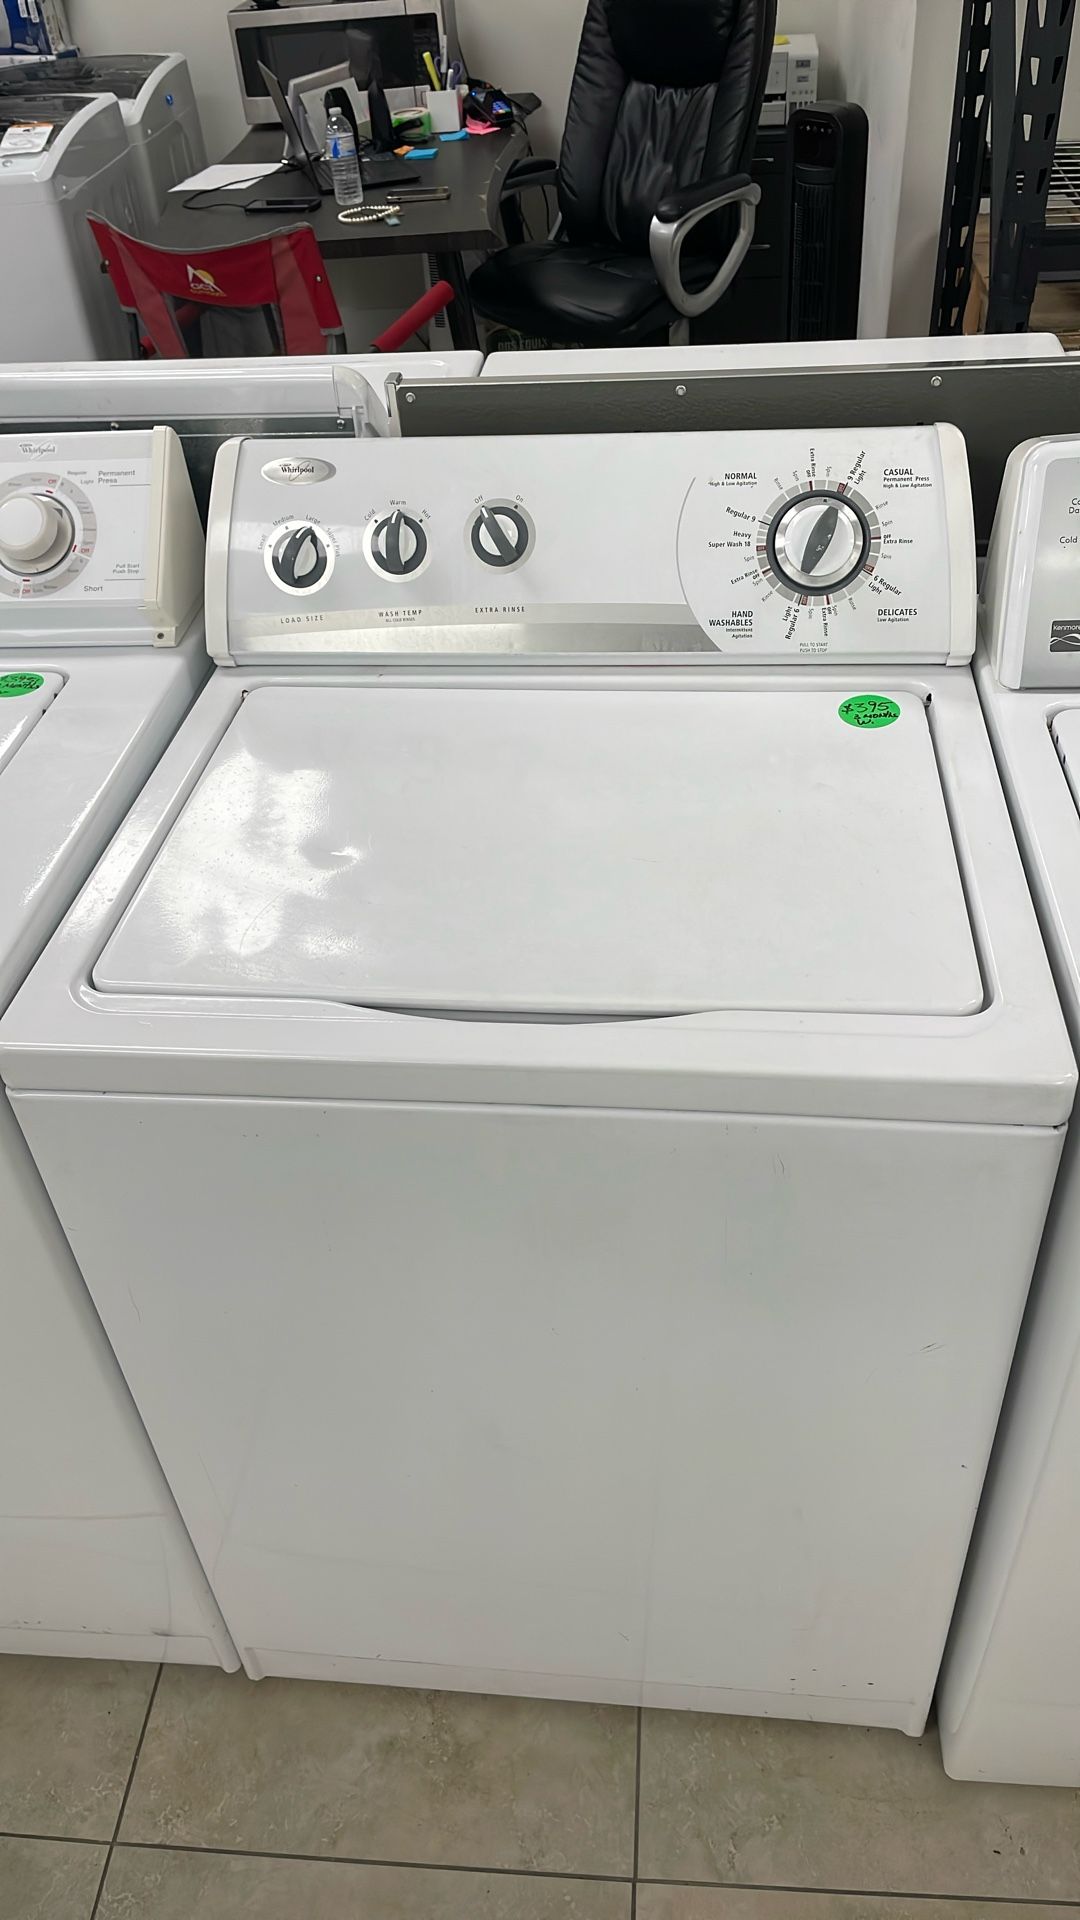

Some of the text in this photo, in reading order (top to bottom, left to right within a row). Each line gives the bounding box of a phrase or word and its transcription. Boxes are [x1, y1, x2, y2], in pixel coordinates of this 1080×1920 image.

[849, 450, 866, 476] Regular
[281, 466, 314, 474] Whirlpool
[883, 468, 914, 476] CASUAL
[724, 472, 757, 480] NORMAL
[854, 470, 867, 485] Light
[474, 495, 484, 504] Off
[515, 495, 524, 503] On
[364, 509, 377, 521] Cold
[421, 509, 431, 520] Hot
[725, 506, 750, 520] Regular
[272, 514, 295, 526] Medium
[305, 514, 321, 525] Large
[733, 531, 751, 539] Heavy
[1059, 536, 1078, 544] Cold
[730, 576, 744, 585] Extra
[868, 582, 882, 595] Light
[879, 578, 902, 596] Regular
[782, 606, 793, 621] Light
[877, 608, 917, 616] DELICATES
[280, 616, 302, 624] LOAD
[709, 619, 753, 627] WASHABLES
[785, 614, 798, 640] Regular
[841, 700, 894, 714] $395
